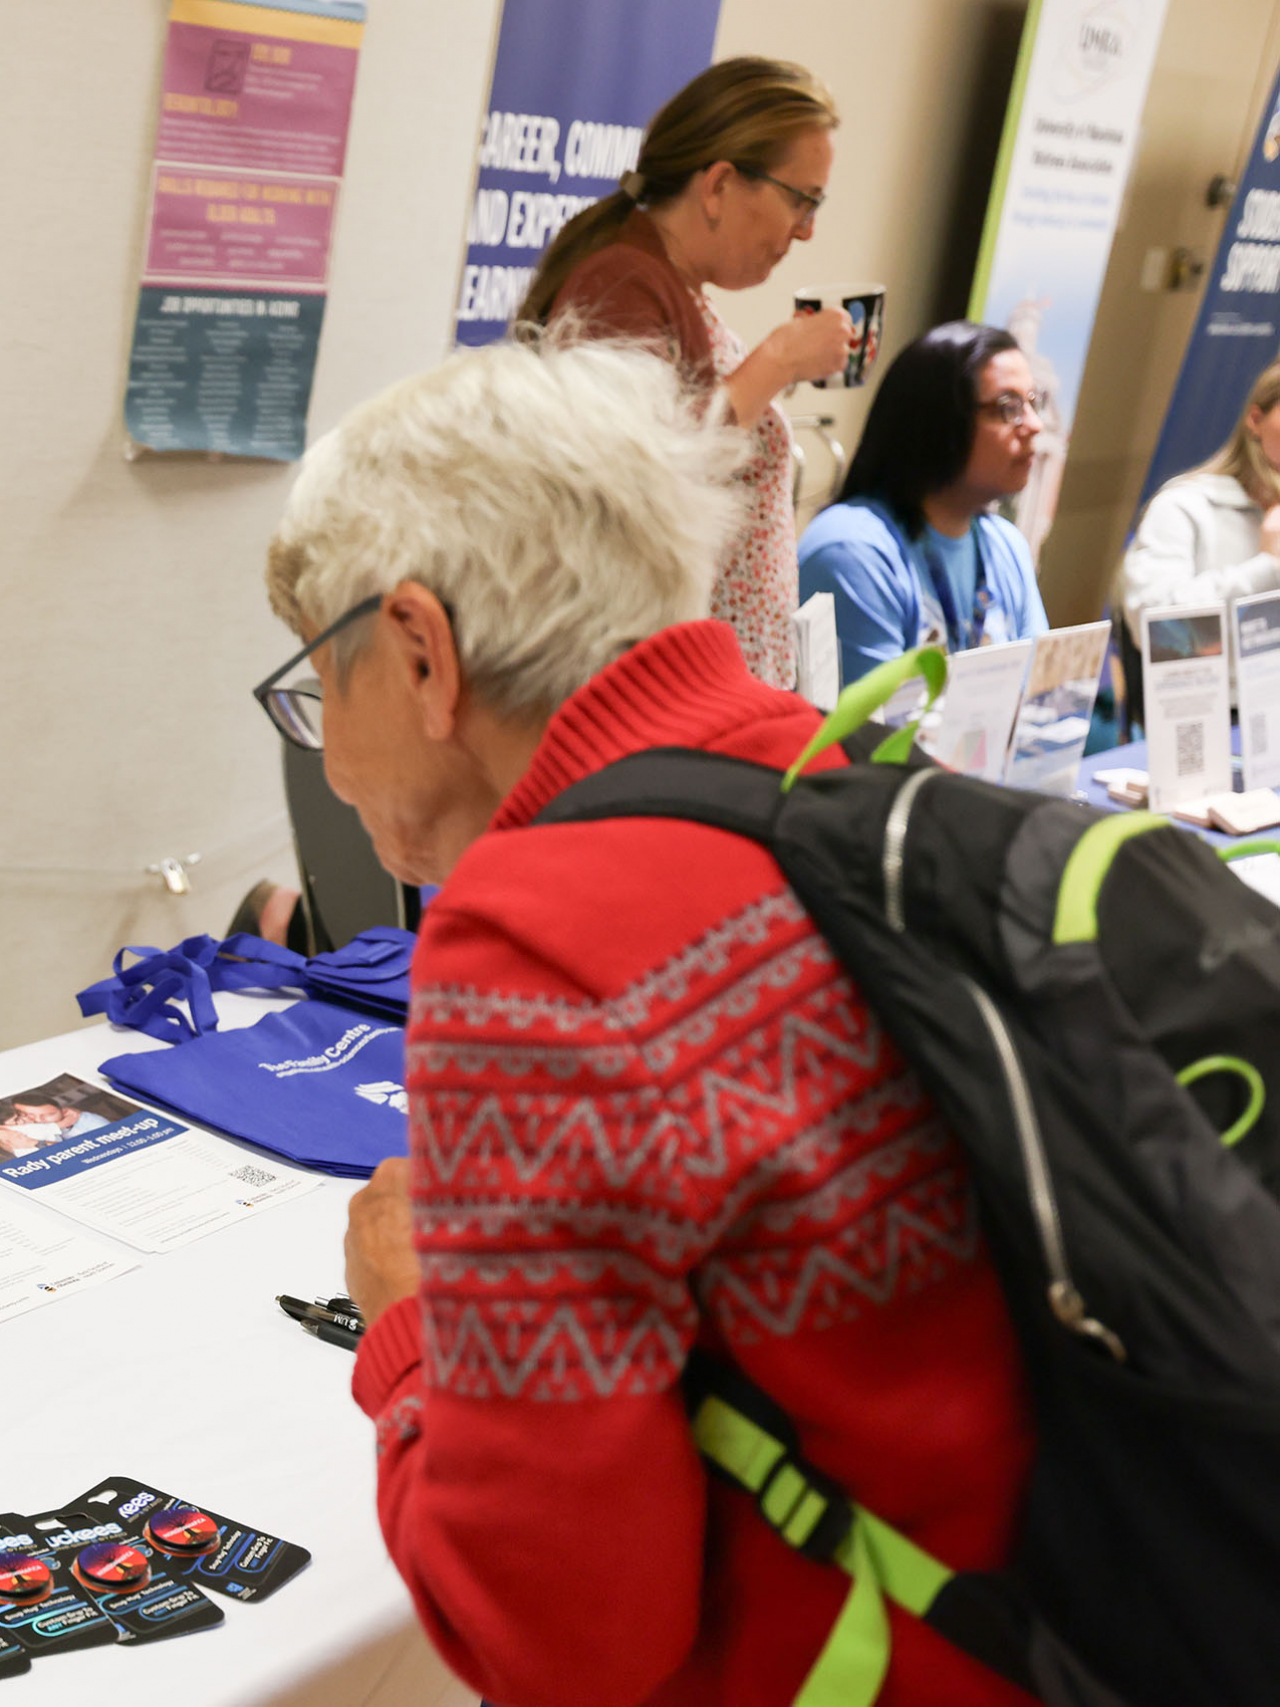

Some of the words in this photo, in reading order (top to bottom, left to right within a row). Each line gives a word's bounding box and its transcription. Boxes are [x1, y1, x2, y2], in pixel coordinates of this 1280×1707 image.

[479, 111, 562, 184] AREER,
[324, 1024, 371, 1058] Centre
[2, 1158, 51, 1178] Rady
[46, 1140, 100, 1165] parent
[95, 1117, 159, 1145] meet-up
